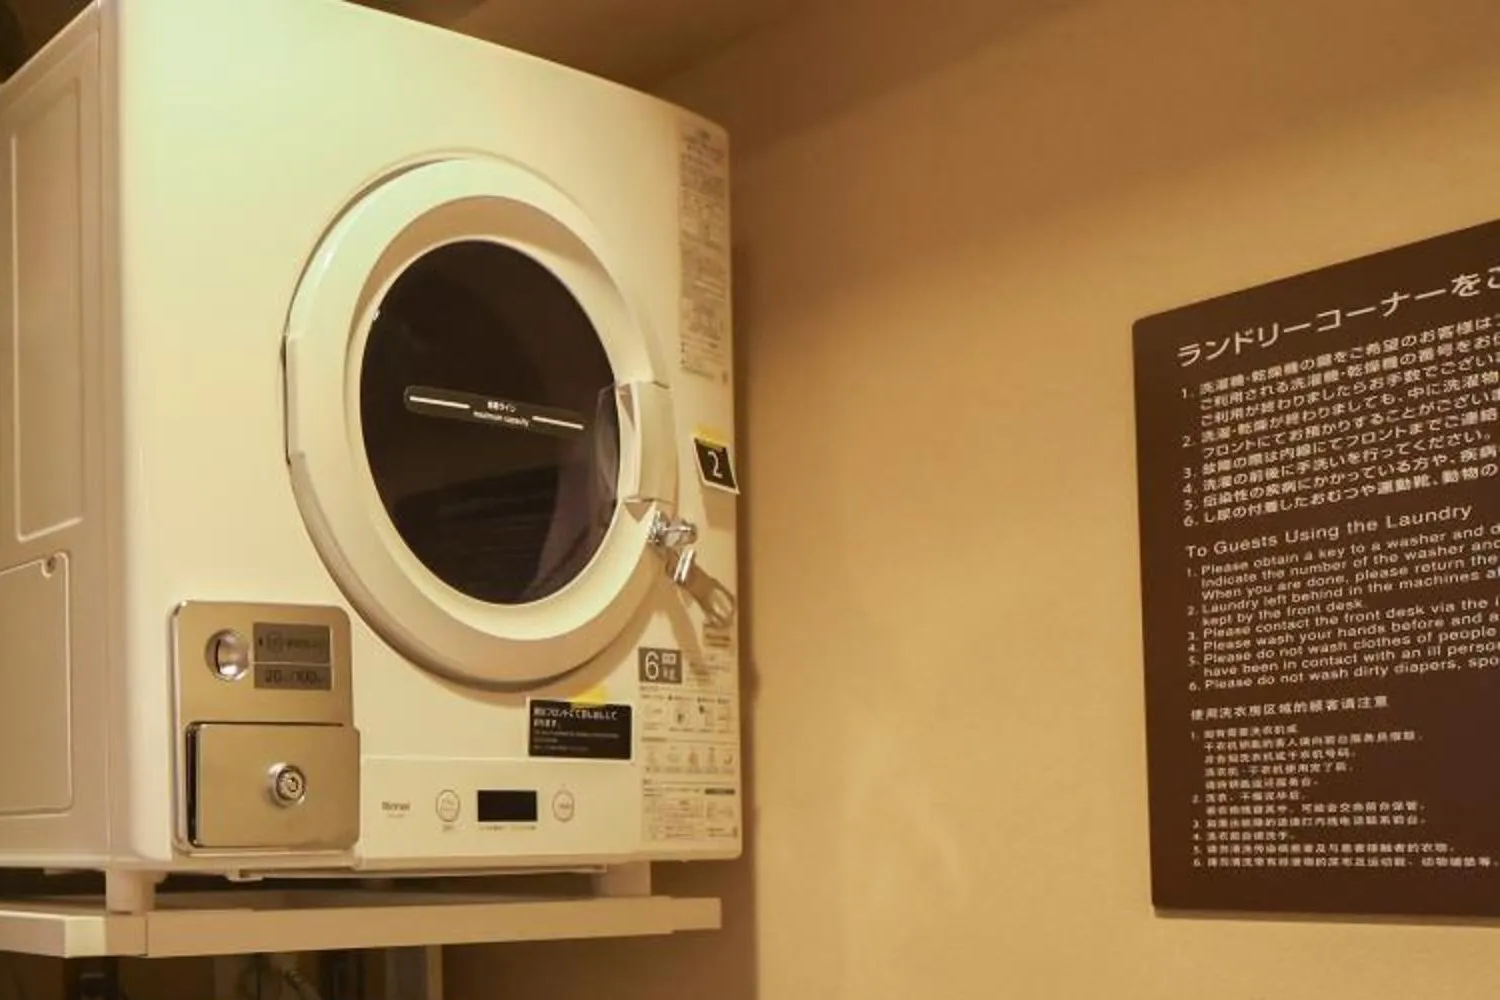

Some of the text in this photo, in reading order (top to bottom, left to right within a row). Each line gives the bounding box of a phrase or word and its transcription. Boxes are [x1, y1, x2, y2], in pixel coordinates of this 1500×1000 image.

[707, 451, 723, 478] 2
[1185, 502, 1472, 559] To Guests Using the Laundry
[1201, 560, 1248, 576] Please
[1253, 552, 1298, 568] obtain
[1303, 550, 1312, 561] a
[1318, 546, 1344, 561] key
[1350, 542, 1365, 555] to
[1371, 541, 1380, 552] a
[1385, 531, 1446, 550] washer
[1452, 525, 1484, 540] and
[1201, 572, 1257, 589] Indicate
[1261, 568, 1284, 581] the
[1289, 559, 1346, 577] number
[1352, 556, 1368, 568] of
[1373, 552, 1398, 565] the
[1404, 543, 1464, 561] washer
[1201, 552, 1498, 602] When you are done, please return the
[1201, 598, 1258, 616] Laundry
[1263, 594, 1286, 608] left
[1291, 587, 1342, 603] behind
[1348, 584, 1362, 596] in
[1367, 580, 1392, 594] the
[1399, 569, 1479, 590] machines
[1202, 614, 1232, 628] kept
[1236, 612, 1253, 624] by
[1258, 608, 1281, 621] the
[1286, 603, 1321, 617] front
[1203, 624, 1250, 639] Please
[1255, 618, 1309, 634] contact
[1314, 614, 1338, 627] the
[1343, 610, 1380, 624] front
[1385, 604, 1425, 619] desk
[1430, 601, 1454, 614] via
[1461, 597, 1488, 610] the
[1203, 637, 1251, 653] Please
[1256, 633, 1294, 647] wash
[1299, 629, 1332, 644] your
[1337, 623, 1386, 638] hands
[1391, 616, 1444, 632] before
[1450, 612, 1482, 626] and
[1488, 611, 1499, 622] a
[645, 651, 659, 680] 6
[1203, 651, 1252, 666] Please
[1255, 648, 1274, 660] do
[1279, 645, 1303, 657] not
[1307, 641, 1347, 654] wash
[1353, 634, 1410, 650] clothes
[1416, 632, 1432, 644] of
[1438, 626, 1496, 644] people
[1203, 664, 1238, 678] have
[1241, 660, 1278, 674] been
[1283, 659, 1296, 670] in
[1301, 653, 1357, 669] contact
[1363, 649, 1395, 663] with
[1401, 648, 1421, 659] an
[1204, 675, 1252, 690] Please
[1257, 673, 1274, 685] do
[1280, 671, 1303, 684] not
[1308, 667, 1348, 681] wash
[1353, 663, 1388, 679] dirty
[1393, 656, 1461, 676] diapers,
